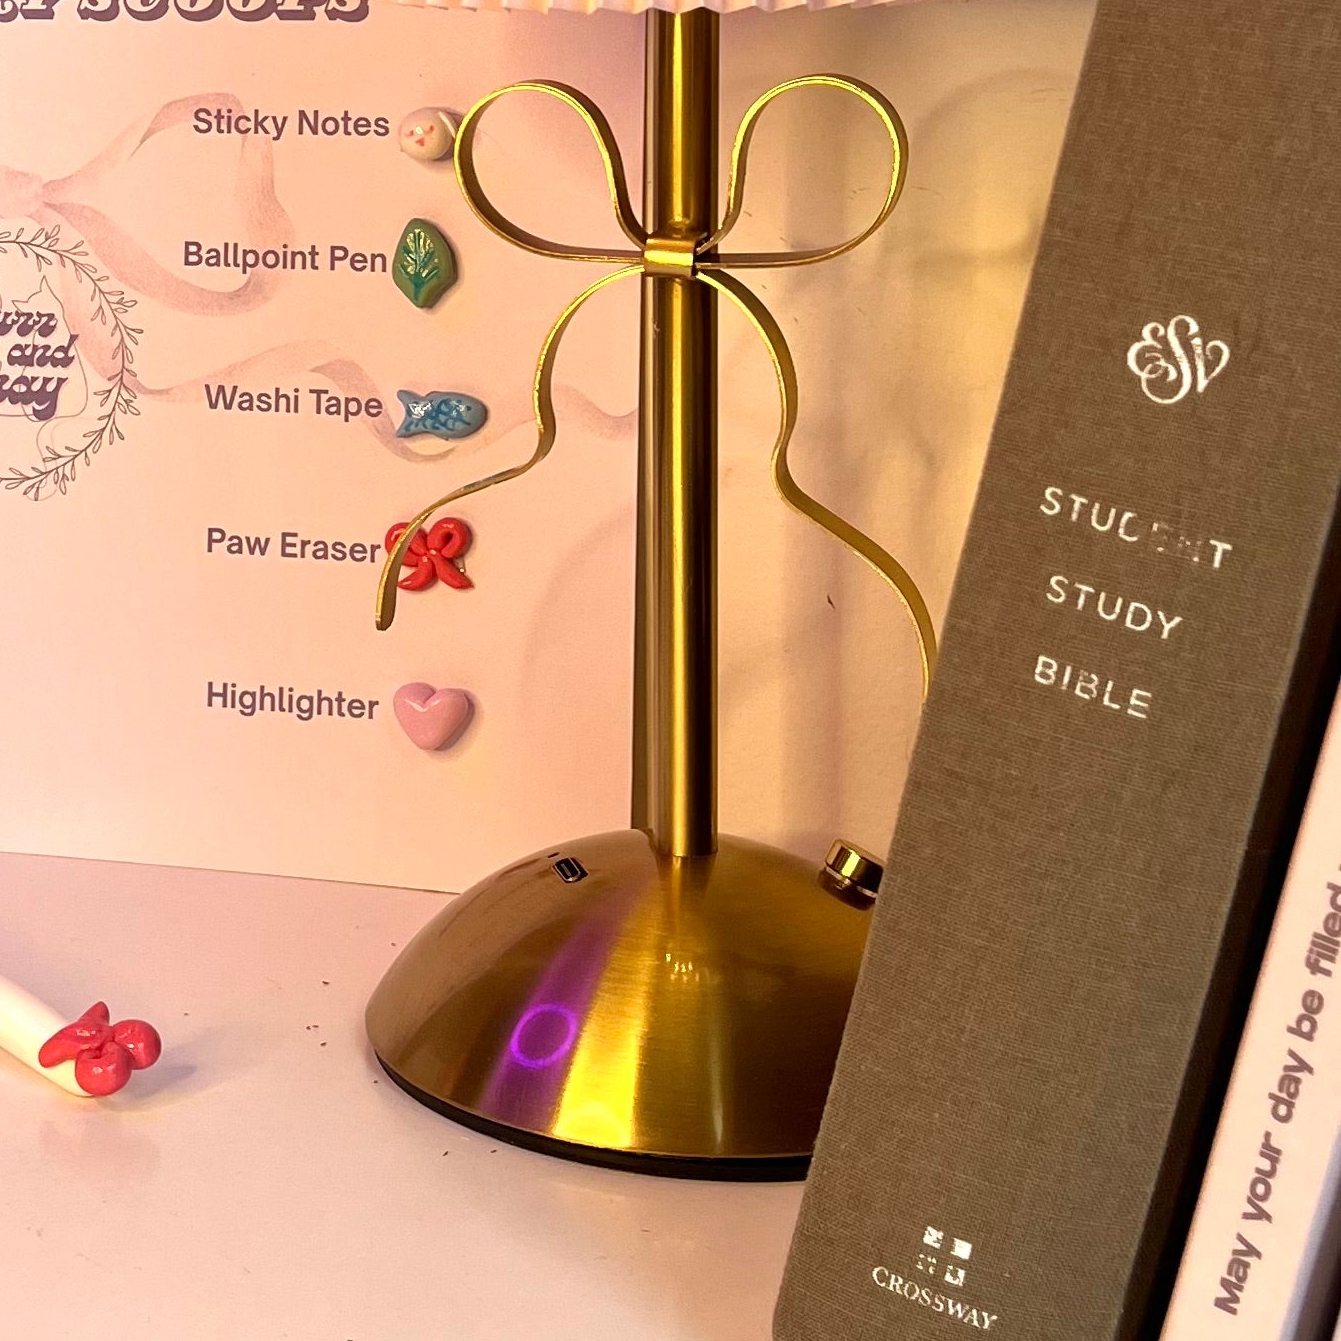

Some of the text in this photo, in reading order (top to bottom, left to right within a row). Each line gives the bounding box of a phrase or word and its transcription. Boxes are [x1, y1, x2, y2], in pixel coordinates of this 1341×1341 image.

[192, 107, 390, 142] Sticky Notes
[183, 240, 387, 275] Ballpoint Pen
[7, 333, 79, 369] and
[1126, 314, 1231, 405] ESV
[204, 383, 384, 423] Washi Tape
[206, 527, 382, 564] Paw Eraser
[1045, 575, 1183, 640] STUDY
[206, 681, 380, 722] Highlighter
[1033, 654, 1153, 720] BIBLE
[1285, 989, 1325, 1042] be
[1267, 1048, 1315, 1124] day
[1241, 1131, 1284, 1224] your
[871, 1265, 999, 1332] CROSSWAY
[1212, 1232, 1263, 1316] May
